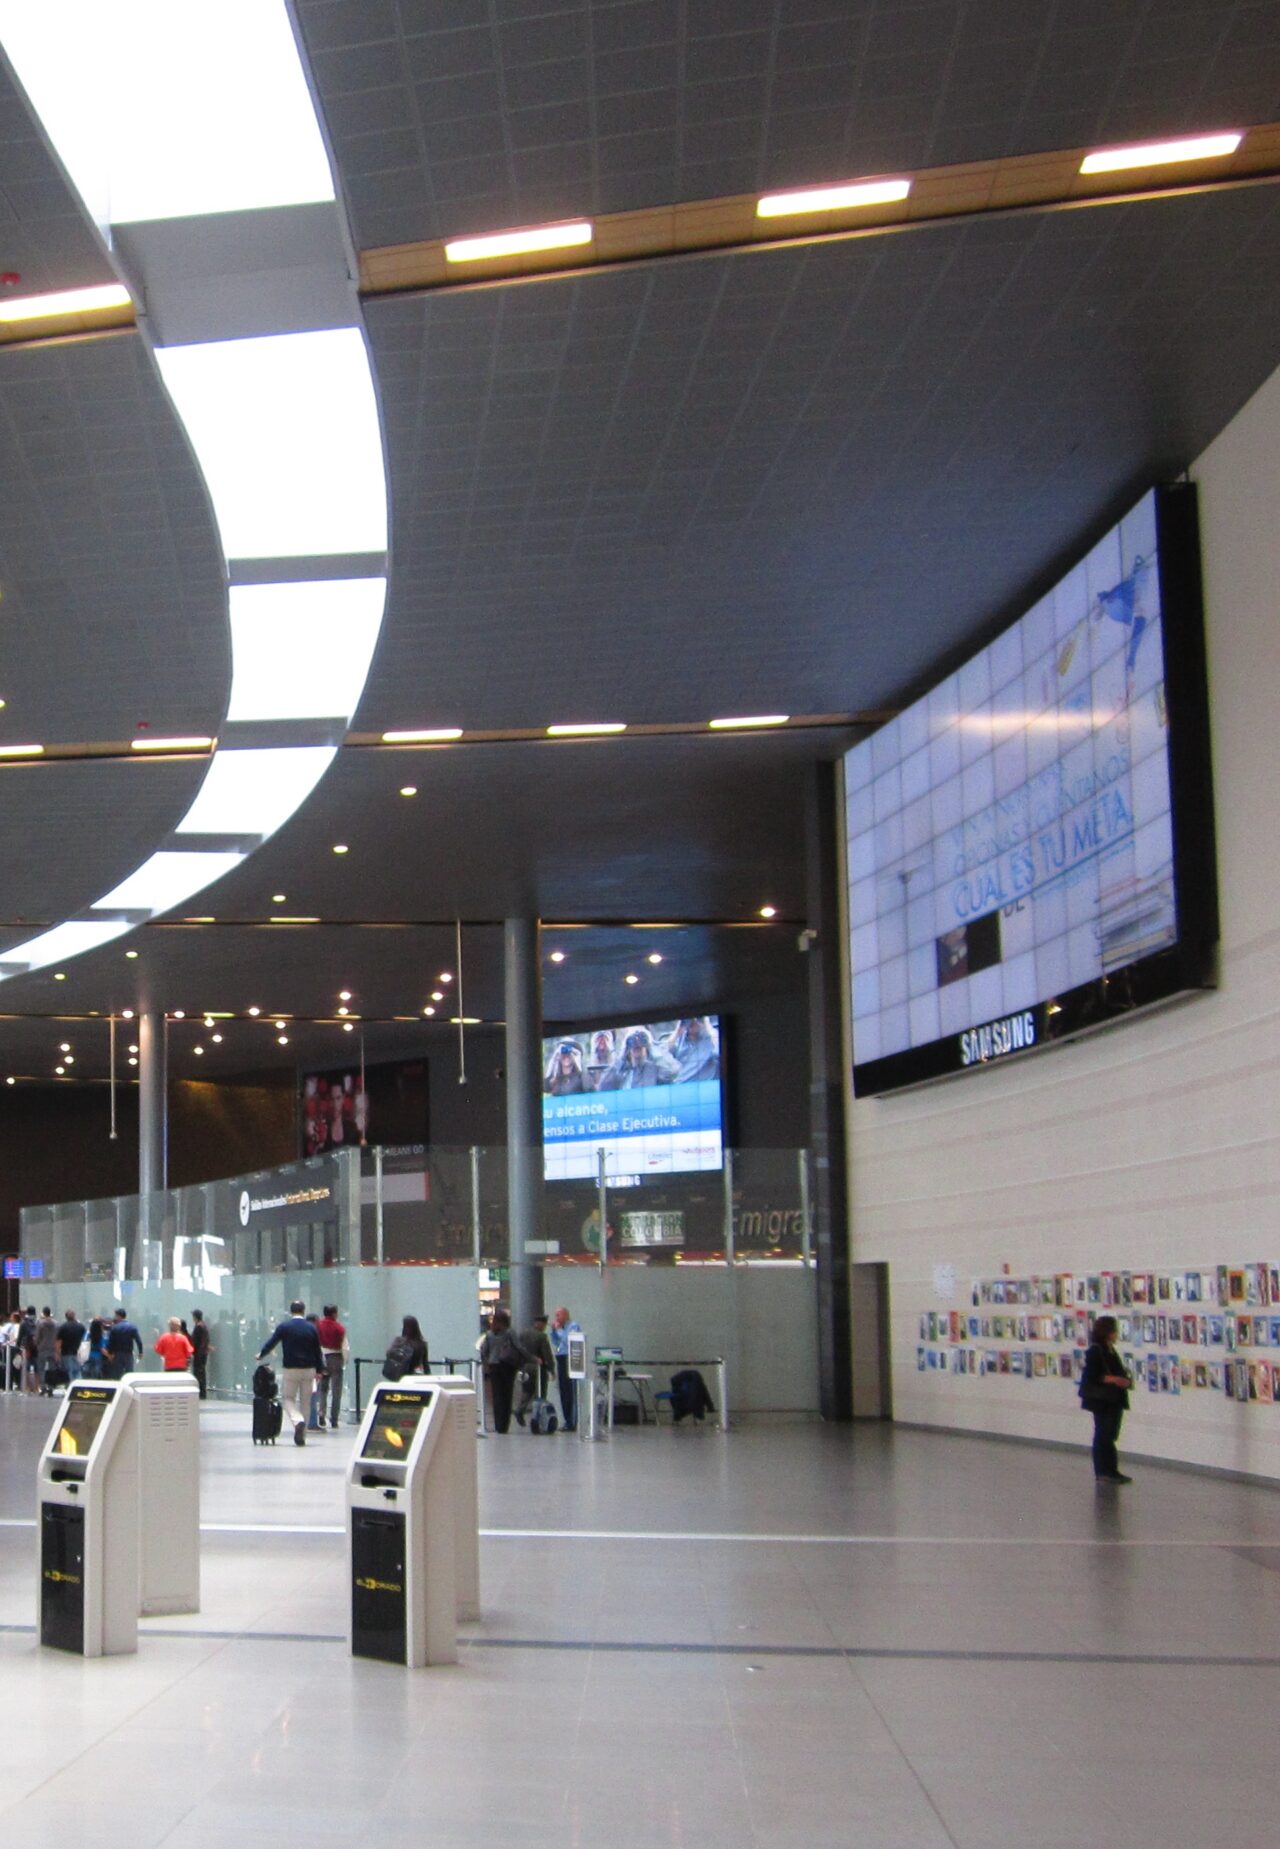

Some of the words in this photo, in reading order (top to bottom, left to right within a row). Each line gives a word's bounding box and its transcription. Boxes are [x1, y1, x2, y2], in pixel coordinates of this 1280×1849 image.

[960, 1011, 1035, 1065] SAMSUNG
[557, 1103, 608, 1118] alcance,
[578, 1124, 585, 1134] a
[588, 1120, 619, 1133] Clase
[623, 1115, 681, 1132] Ejecutiva.
[595, 1175, 641, 1189] SMSUNG
